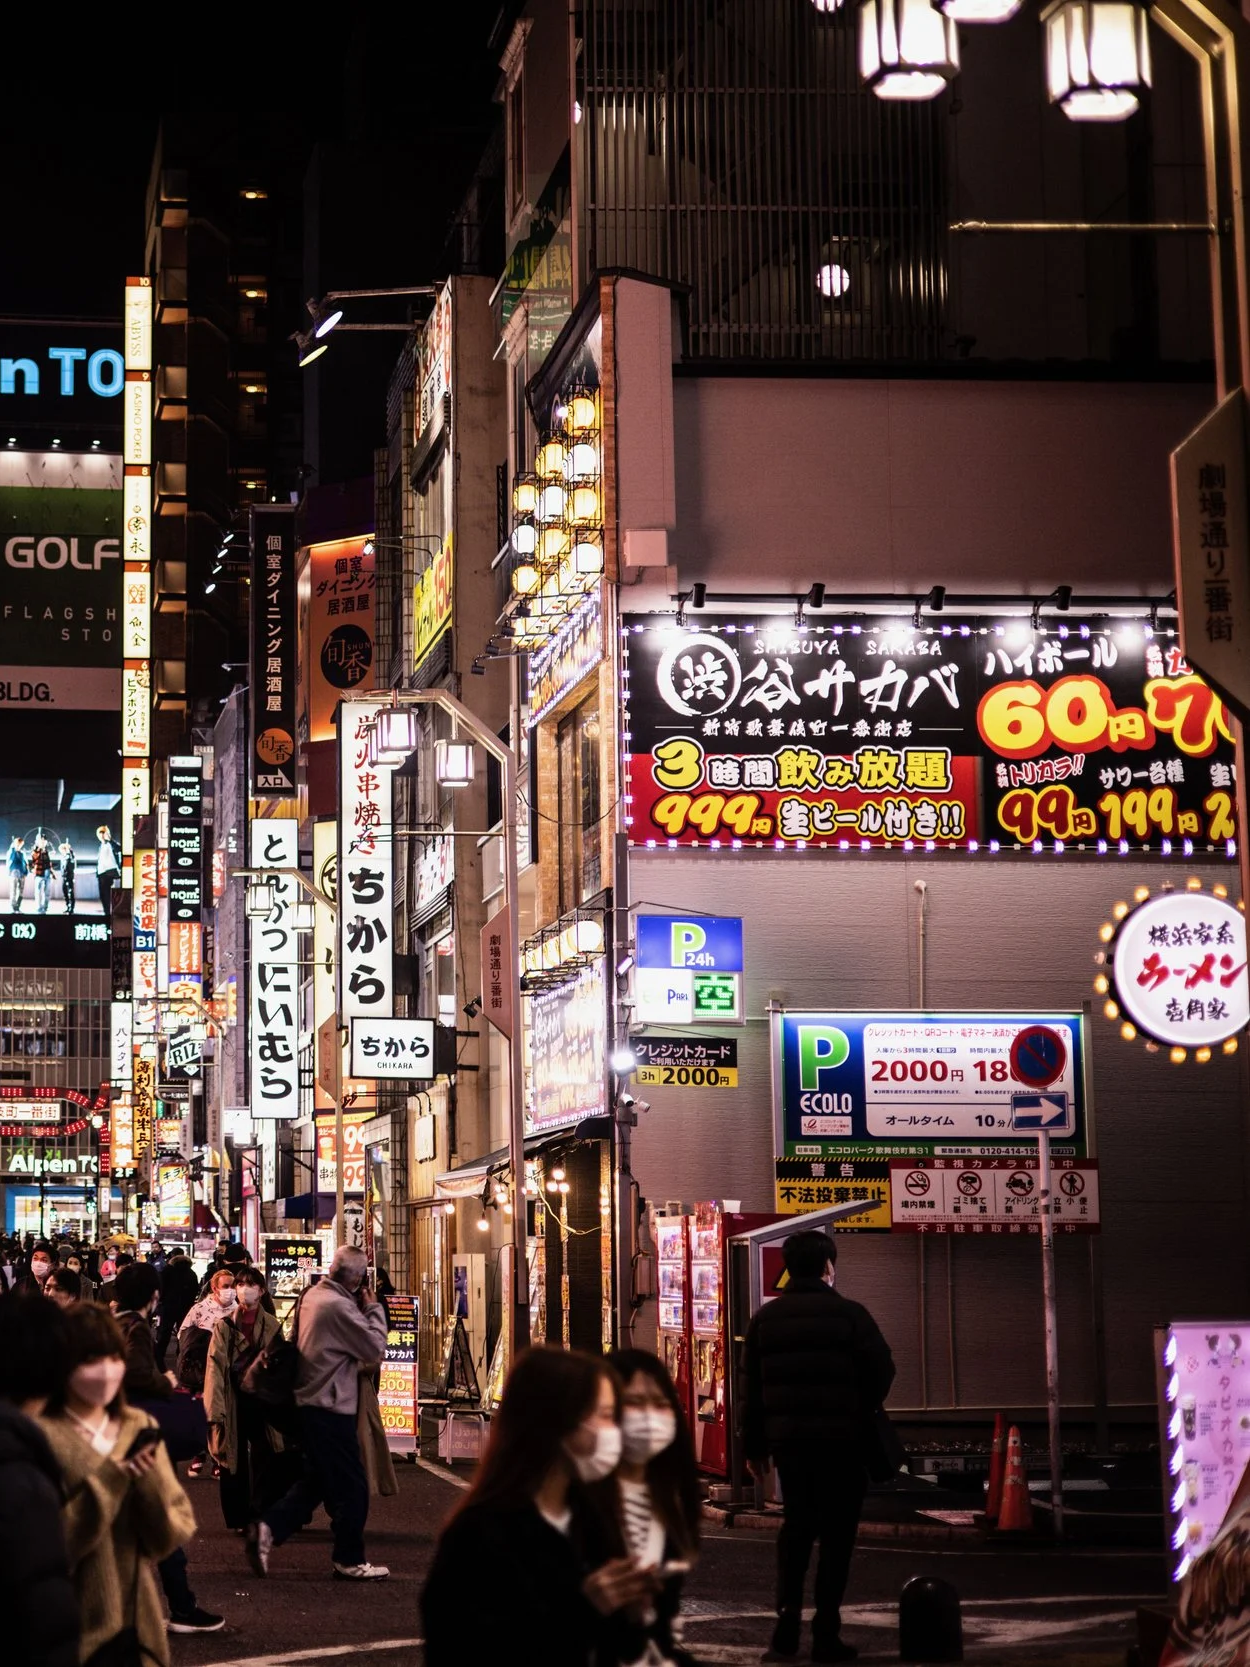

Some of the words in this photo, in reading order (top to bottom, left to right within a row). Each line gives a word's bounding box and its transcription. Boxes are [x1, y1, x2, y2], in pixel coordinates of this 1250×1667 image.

[139, 278, 149, 287] 10
[131, 319, 141, 357] ABYSS
[142, 372, 149, 380] 9
[133, 385, 142, 425] CASINO
[133, 428, 142, 460] POKER
[142, 467, 148, 475] 8
[4, 537, 120, 570] GOLF
[1199, 463, 1233, 643] 劇場通り一番街
[327, 594, 370, 616] 居酒屋
[266, 535, 282, 711] 個室ダイニング居酒屋
[753, 640, 840, 655] SHIBUYA
[865, 640, 943, 655] SAKABA
[984, 637, 1118, 676] ハイボール
[141, 661, 147, 669] 6
[670, 648, 960, 717] 渋谷サカバ
[982, 678, 1147, 750] 60円
[701, 718, 914, 738] 新宿歌舞伎町一番街店
[141, 760, 147, 768] 5
[654, 739, 949, 790] 3時間飲み放題
[1099, 759, 1185, 789] サワー各種
[1210, 762, 1236, 787] 生
[261, 776, 283, 787] 入口
[653, 793, 773, 836] 999円
[780, 798, 962, 838] 生ビール付き!!
[998, 785, 1096, 843] 99円
[1099, 787, 1200, 840] 199円
[135, 936, 156, 948] B1
[347, 867, 388, 1005] ちから
[671, 922, 707, 967] P
[1148, 921, 1235, 947] 横浜家系
[686, 953, 715, 966] 24h
[489, 934, 502, 1009] 劇場通り一番街
[1136, 952, 1248, 993] ラーメン
[694, 976, 735, 1017] 空
[1165, 997, 1230, 1022] 壱角家
[360, 1036, 430, 1058] ちから
[636, 1044, 731, 1058] クレジットカード
[798, 1025, 850, 1091] P
[377, 1061, 414, 1069] CHIKARA
[649, 1057, 716, 1066] ご利用いただけます
[871, 1060, 964, 1082] 2000円
[641, 1071, 655, 1080] 3h
[662, 1067, 730, 1086] 2000円
[800, 1093, 853, 1114] ECOLO
[885, 1115, 955, 1126] オールタイム
[9, 1154, 77, 1177] Alpen
[115, 1168, 134, 1177] 2F
[811, 1163, 854, 1177] 警告
[780, 1186, 887, 1204] 不法投棄禁止
[901, 1200, 935, 1209] 場内禁煙
[953, 1197, 987, 1205] ゴミ捨て
[1004, 1197, 1039, 1205] アイドリング
